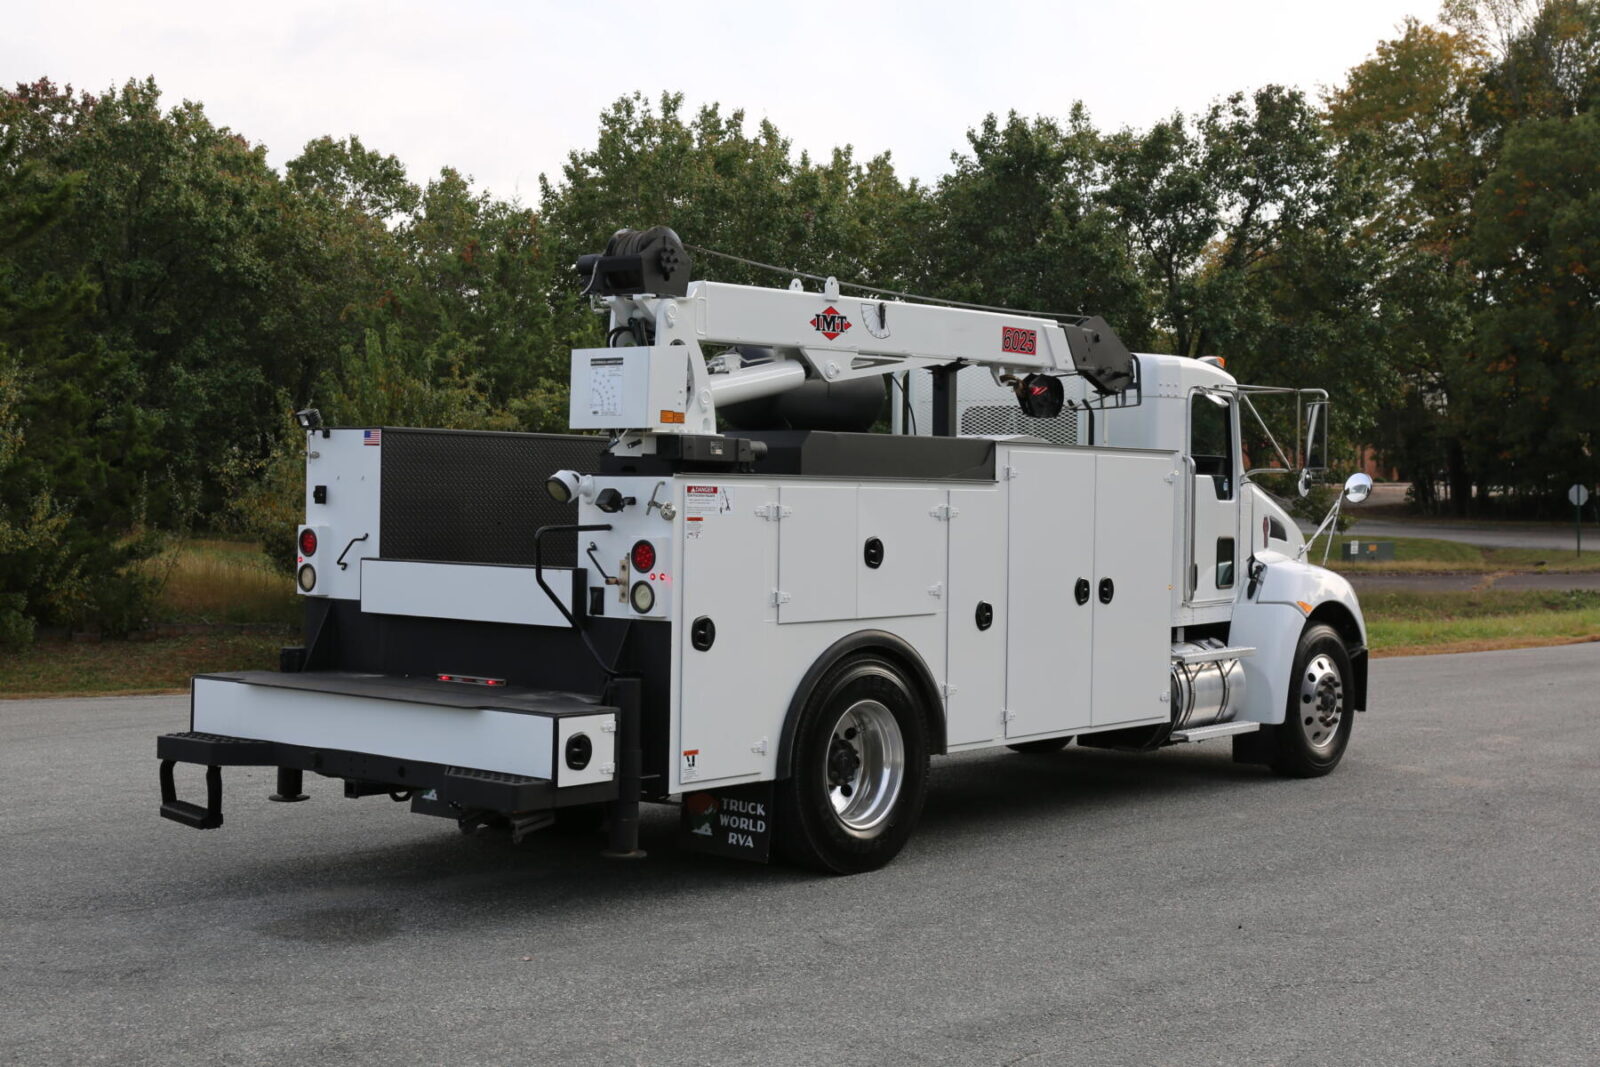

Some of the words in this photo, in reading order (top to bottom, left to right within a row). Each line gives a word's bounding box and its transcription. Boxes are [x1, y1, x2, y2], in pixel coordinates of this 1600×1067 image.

[815, 313, 847, 333] IMT
[1004, 329, 1035, 352] 6025
[722, 798, 766, 816] TRUCK
[720, 814, 766, 832] WORLD
[728, 832, 754, 848] RVA
